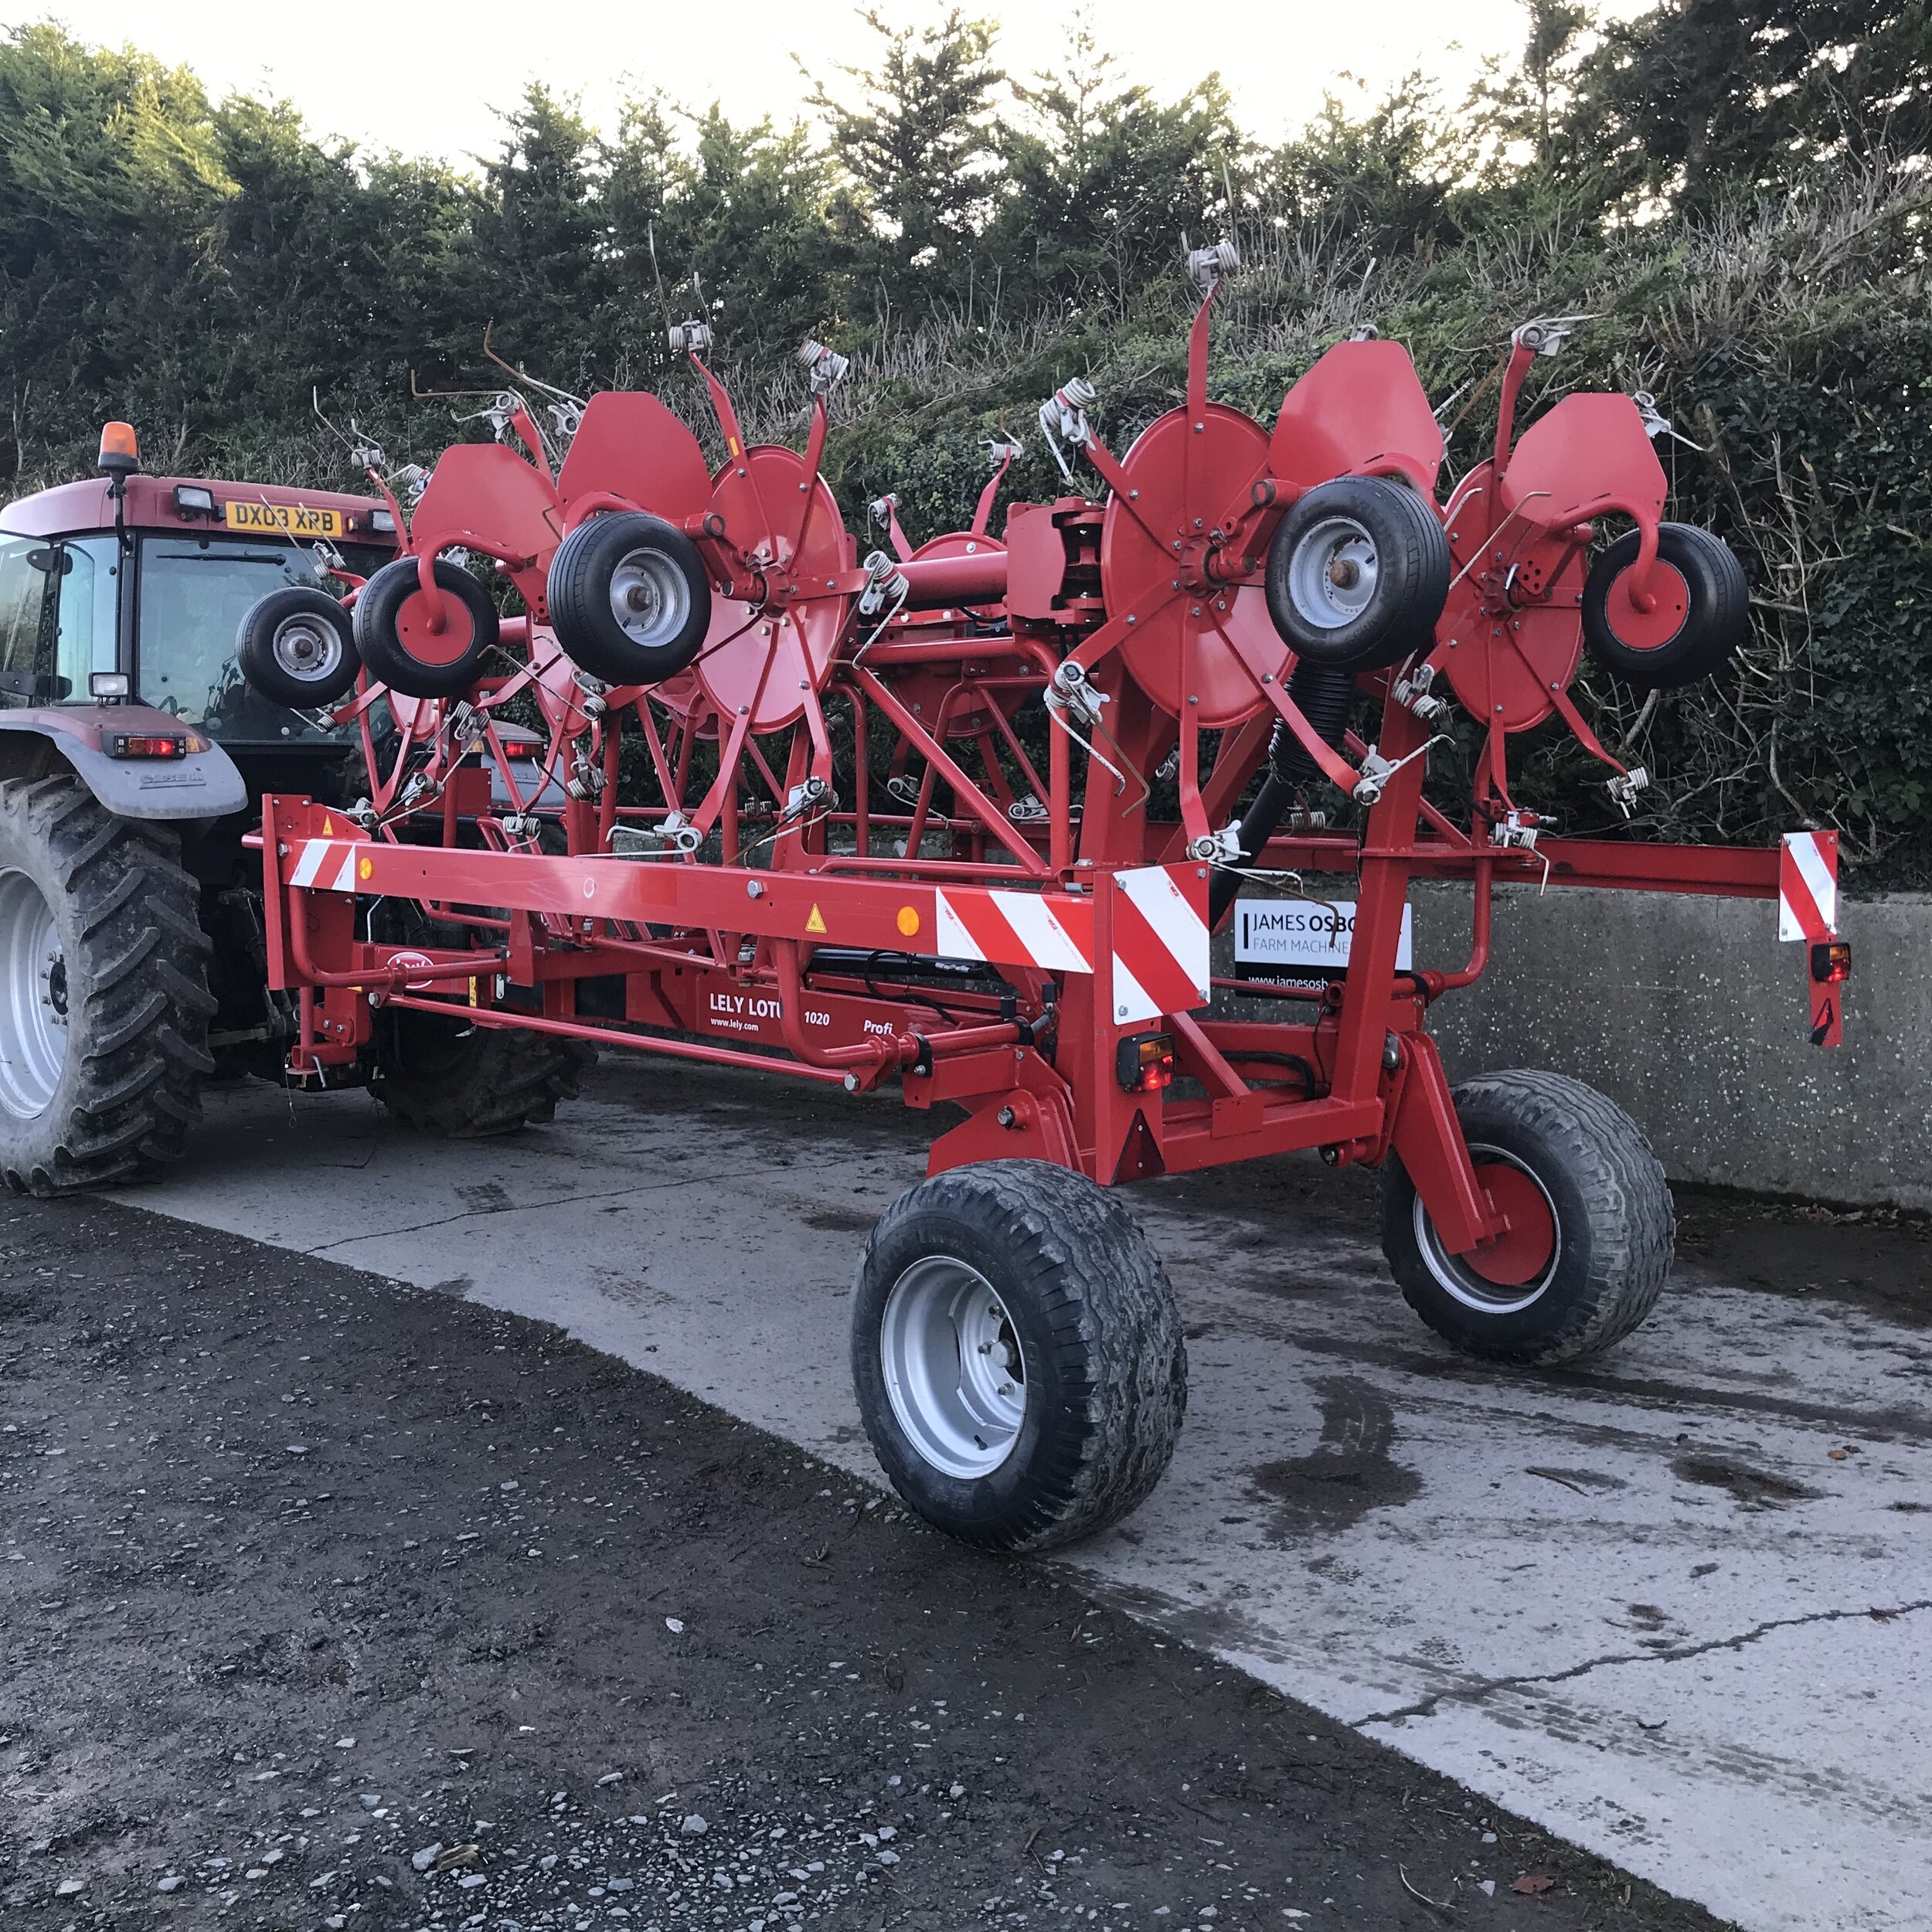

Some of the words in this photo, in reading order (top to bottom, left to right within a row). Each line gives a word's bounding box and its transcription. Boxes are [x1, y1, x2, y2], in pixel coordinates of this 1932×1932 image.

[236, 503, 289, 527] DX03
[1253, 913, 1306, 931] JAMES
[1253, 937, 1287, 951] FARM
[710, 993, 744, 1014] LELY
[804, 1011, 830, 1026] 1020
[863, 1019, 893, 1035] Profi
[710, 1018, 759, 1032] www.lely.com
